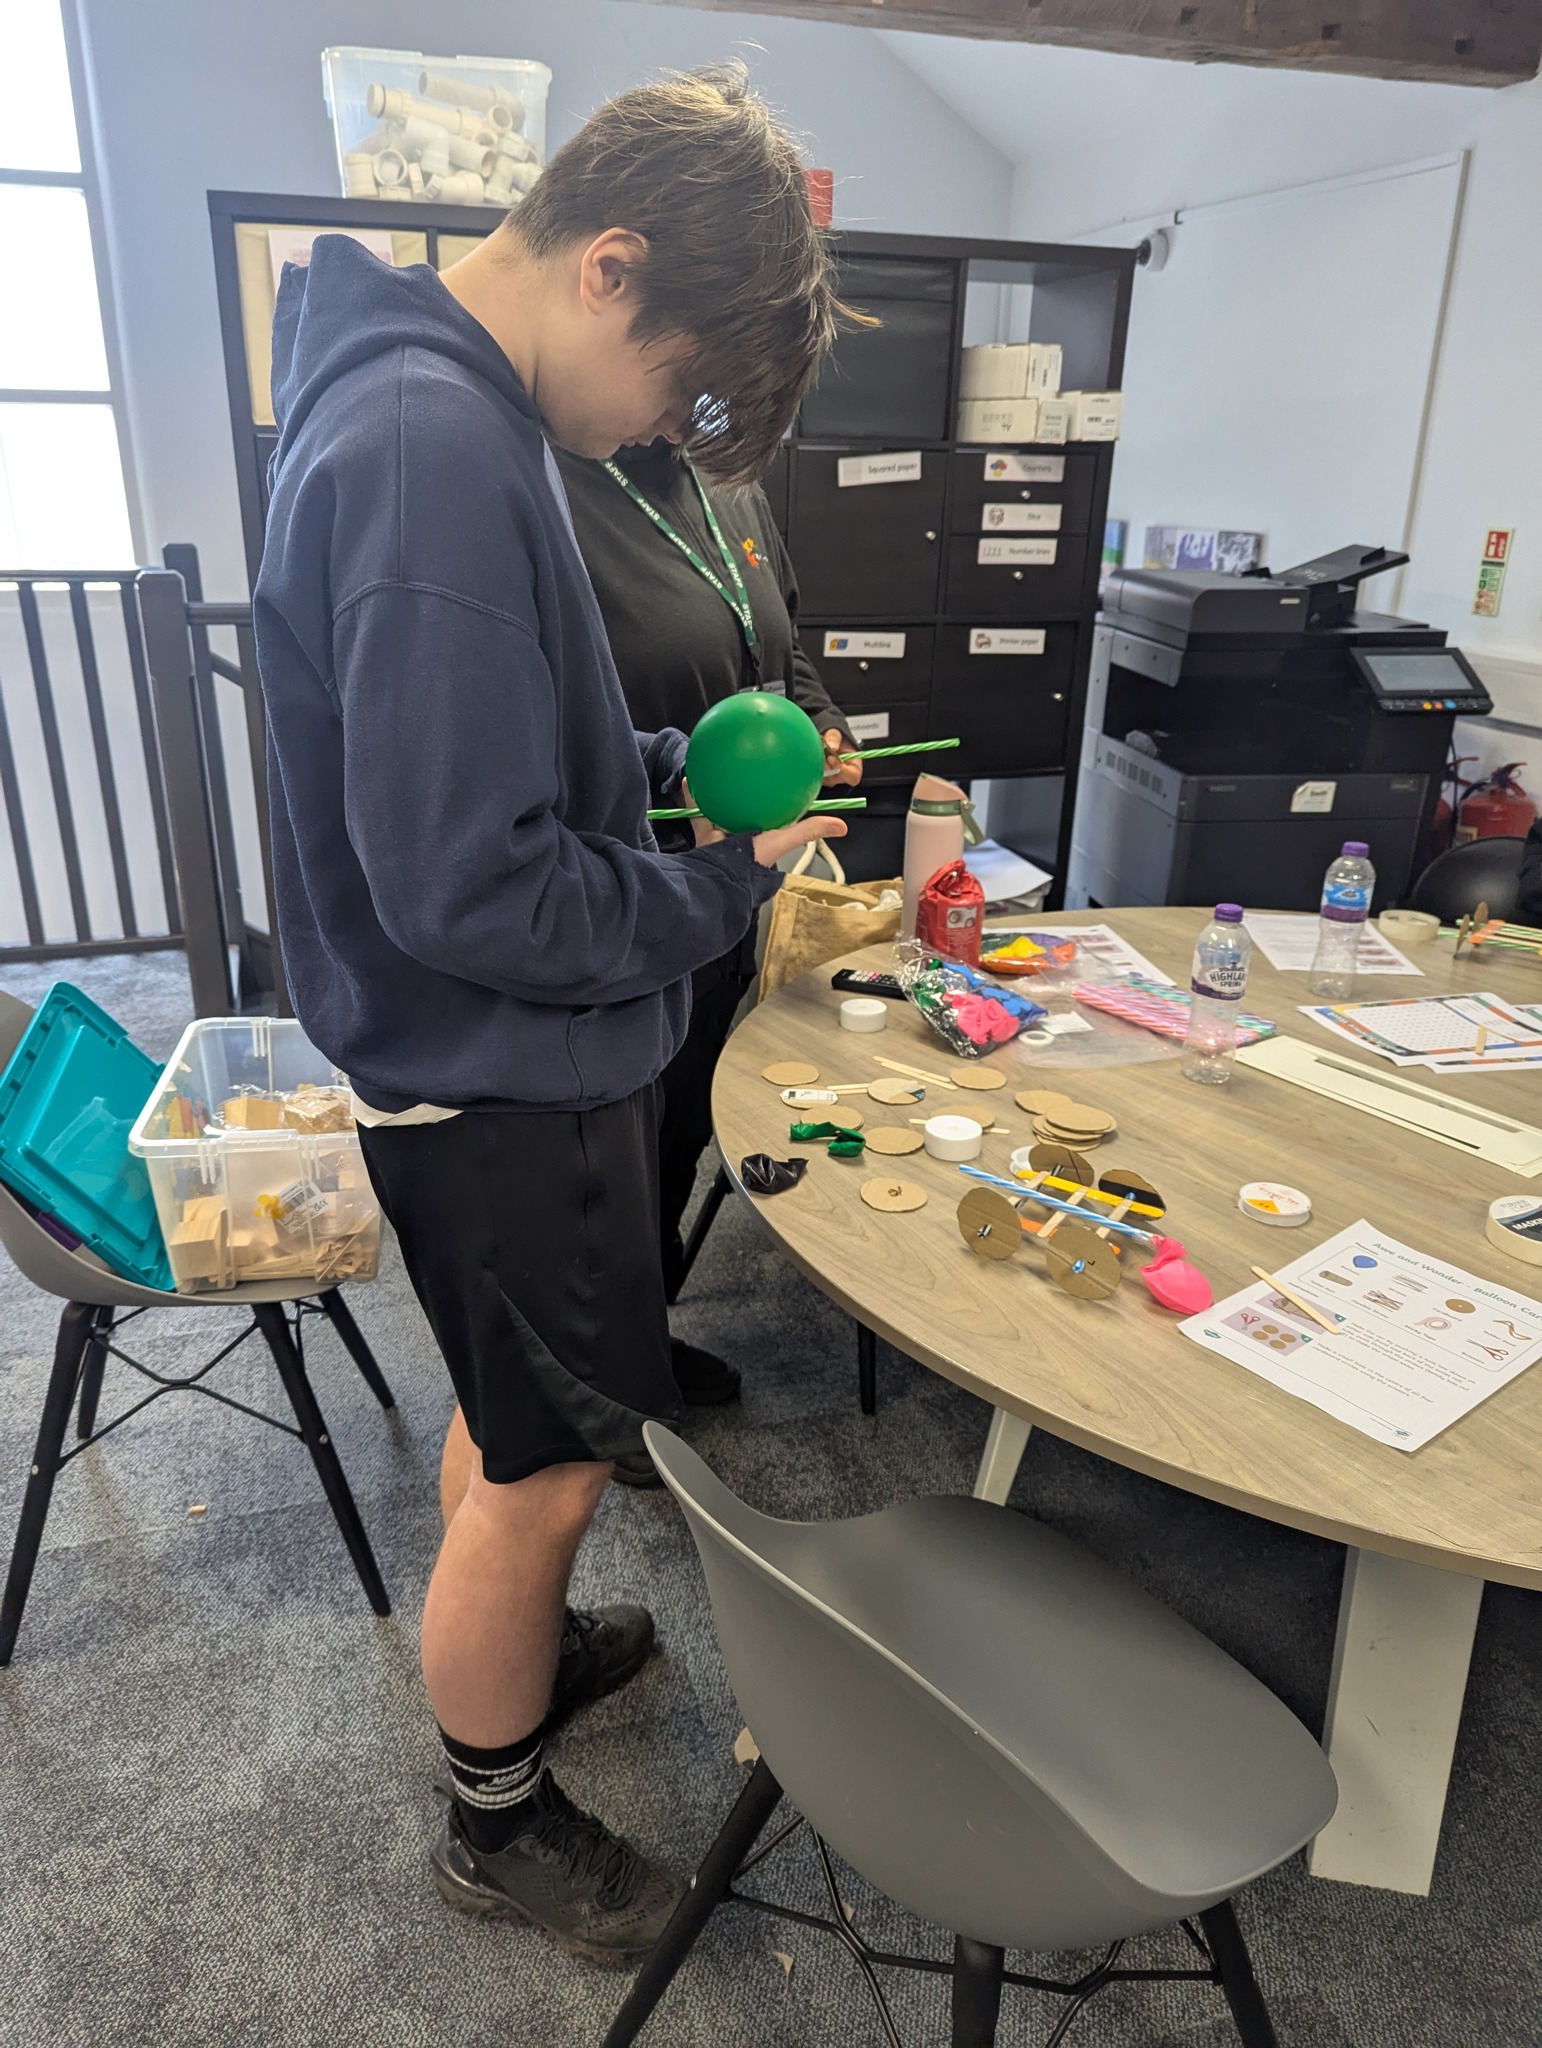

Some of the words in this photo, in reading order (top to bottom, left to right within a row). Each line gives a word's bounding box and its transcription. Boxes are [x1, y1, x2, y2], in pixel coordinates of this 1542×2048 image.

[604, 461, 629, 488] STAFF
[868, 463, 897, 475] Squared
[897, 463, 917, 473] paper
[637, 497, 661, 521] STAFF
[668, 531, 692, 556] STAFF
[712, 524, 728, 551] STAFF
[1009, 547, 1034, 556] Number
[700, 566, 723, 591] STAFF
[728, 561, 744, 589] STAFF
[864, 641, 891, 649] Multilink
[1372, 1243, 1396, 1255] Awe
[1397, 1255, 1420, 1266] and
[1421, 1264, 1463, 1284] Wonder
[1473, 1287, 1517, 1308] Balloon
[1521, 1309, 1542, 1321] Car
